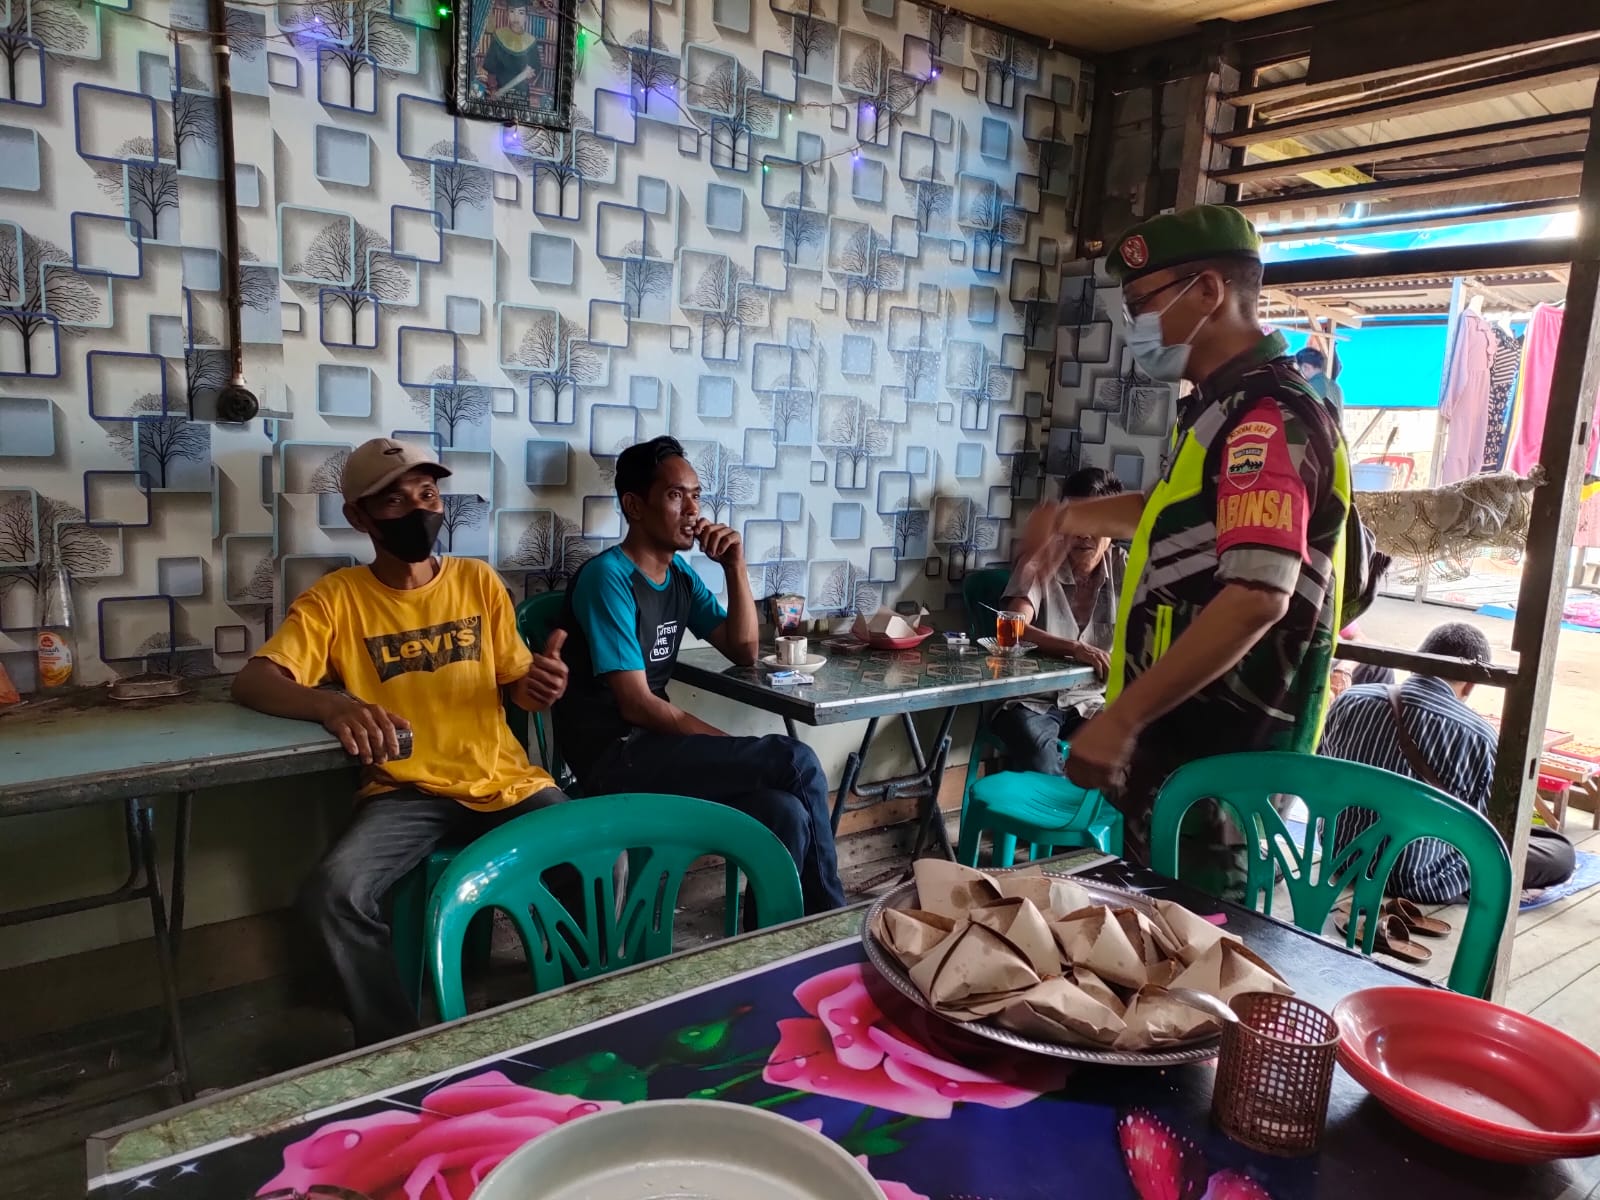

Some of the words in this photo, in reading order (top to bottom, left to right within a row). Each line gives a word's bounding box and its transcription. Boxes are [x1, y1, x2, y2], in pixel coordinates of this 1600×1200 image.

[1216, 490, 1293, 538] ABINSA
[657, 637, 668, 646] HE
[653, 647, 670, 656] BOX
